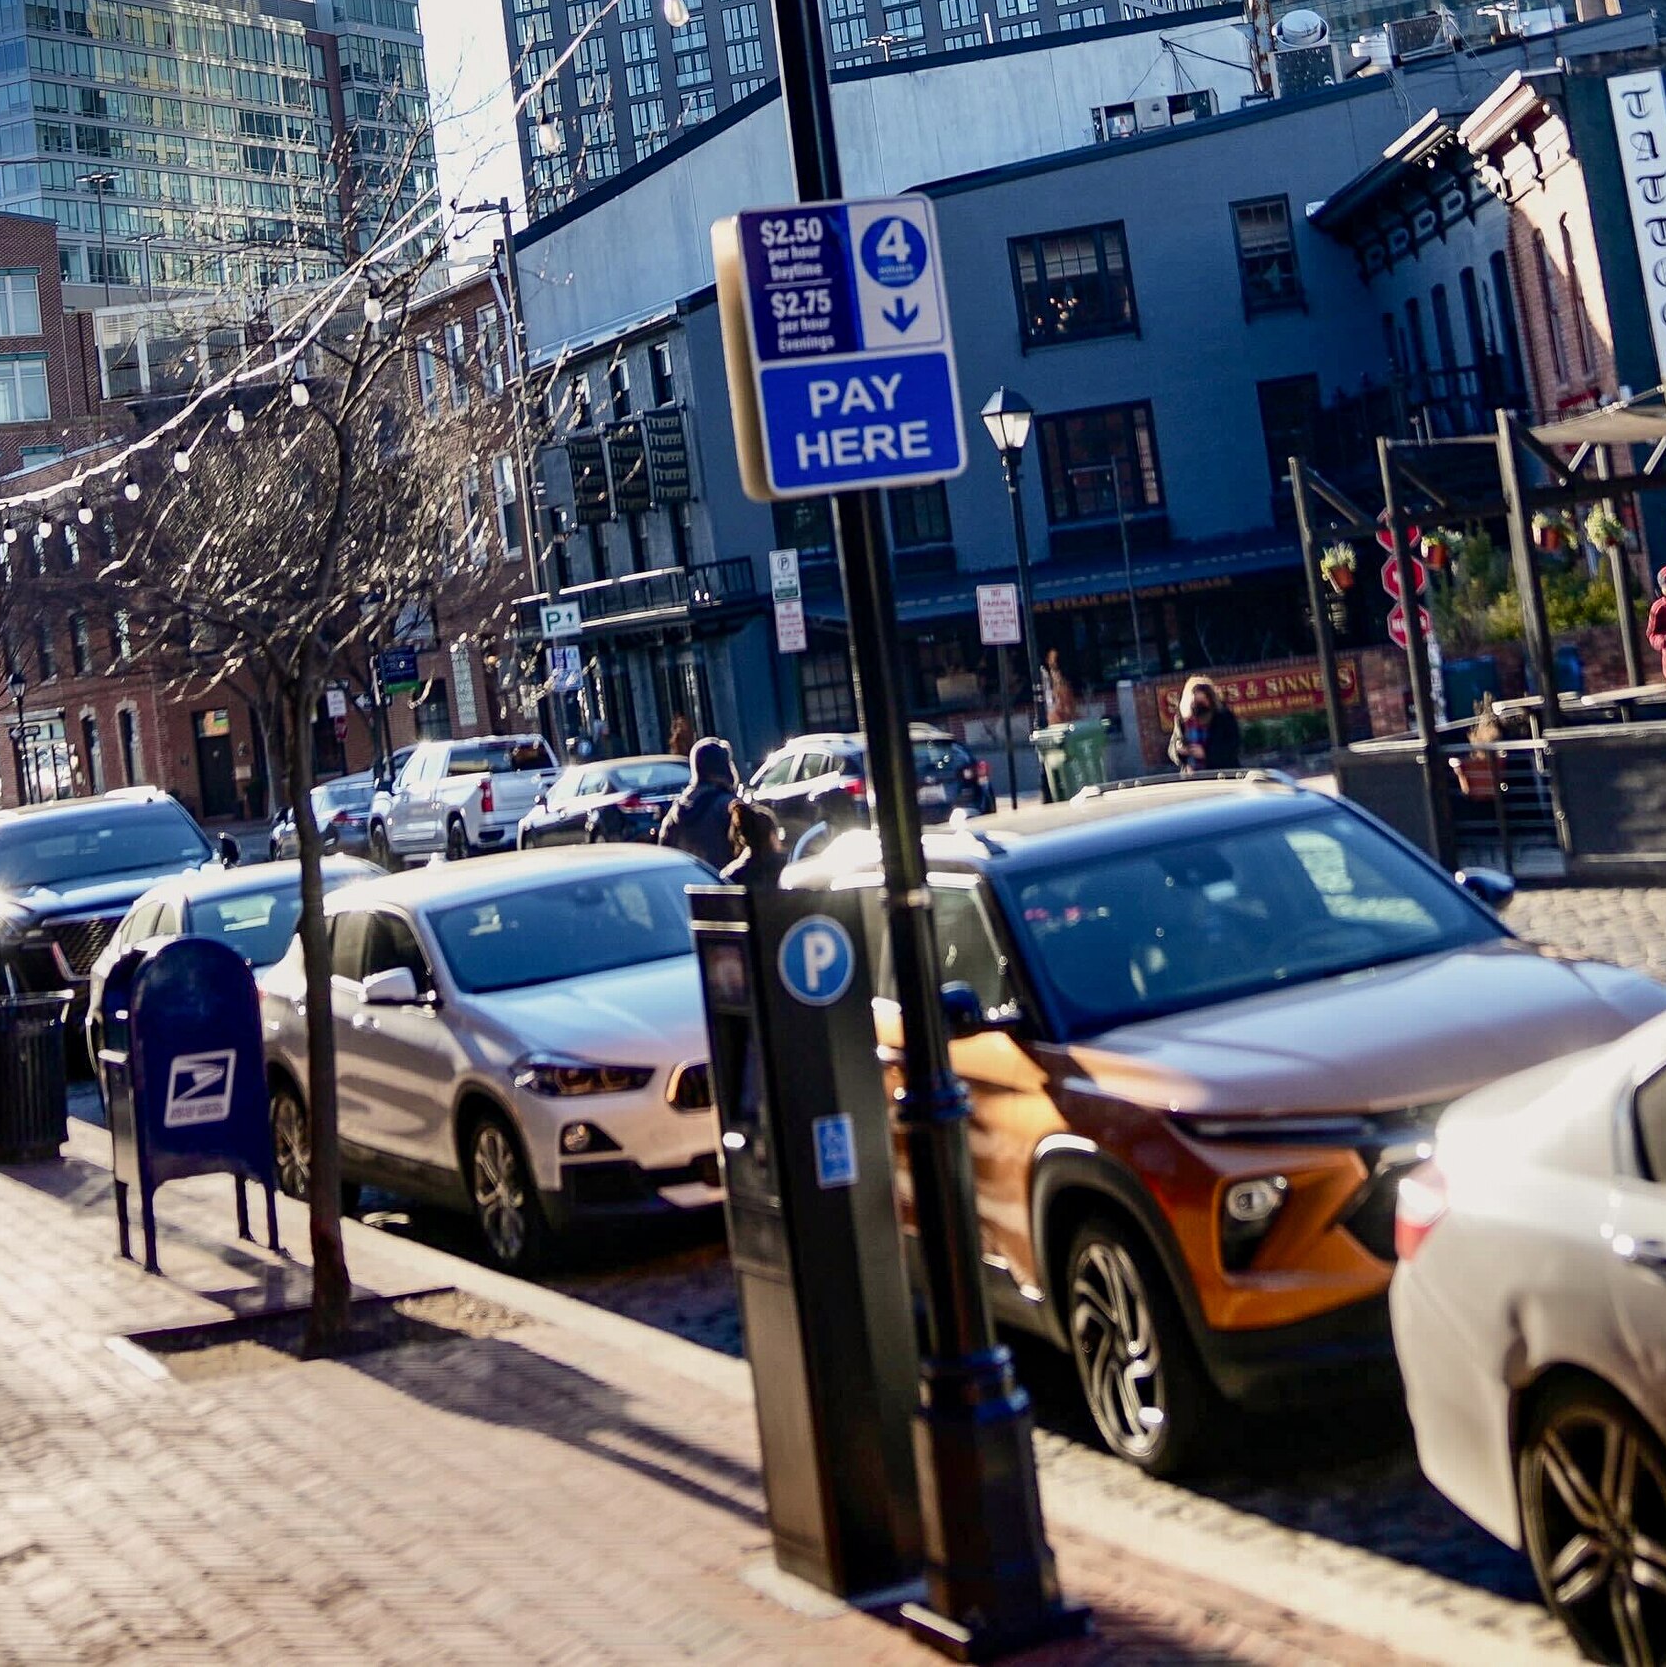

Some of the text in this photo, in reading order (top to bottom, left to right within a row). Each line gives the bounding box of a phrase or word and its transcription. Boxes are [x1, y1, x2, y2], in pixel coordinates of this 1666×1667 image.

[760, 217, 823, 246] $2.50
[875, 219, 911, 263] 4
[768, 243, 821, 265] per hour
[770, 264, 823, 283] Daytime
[770, 289, 831, 319] $2.75
[777, 316, 830, 336] per hour
[777, 332, 835, 353] Evenings
[808, 372, 902, 419] PAY
[795, 420, 932, 471] HERE
[1266, 664, 1352, 697] SINNES
[803, 933, 836, 990] P
